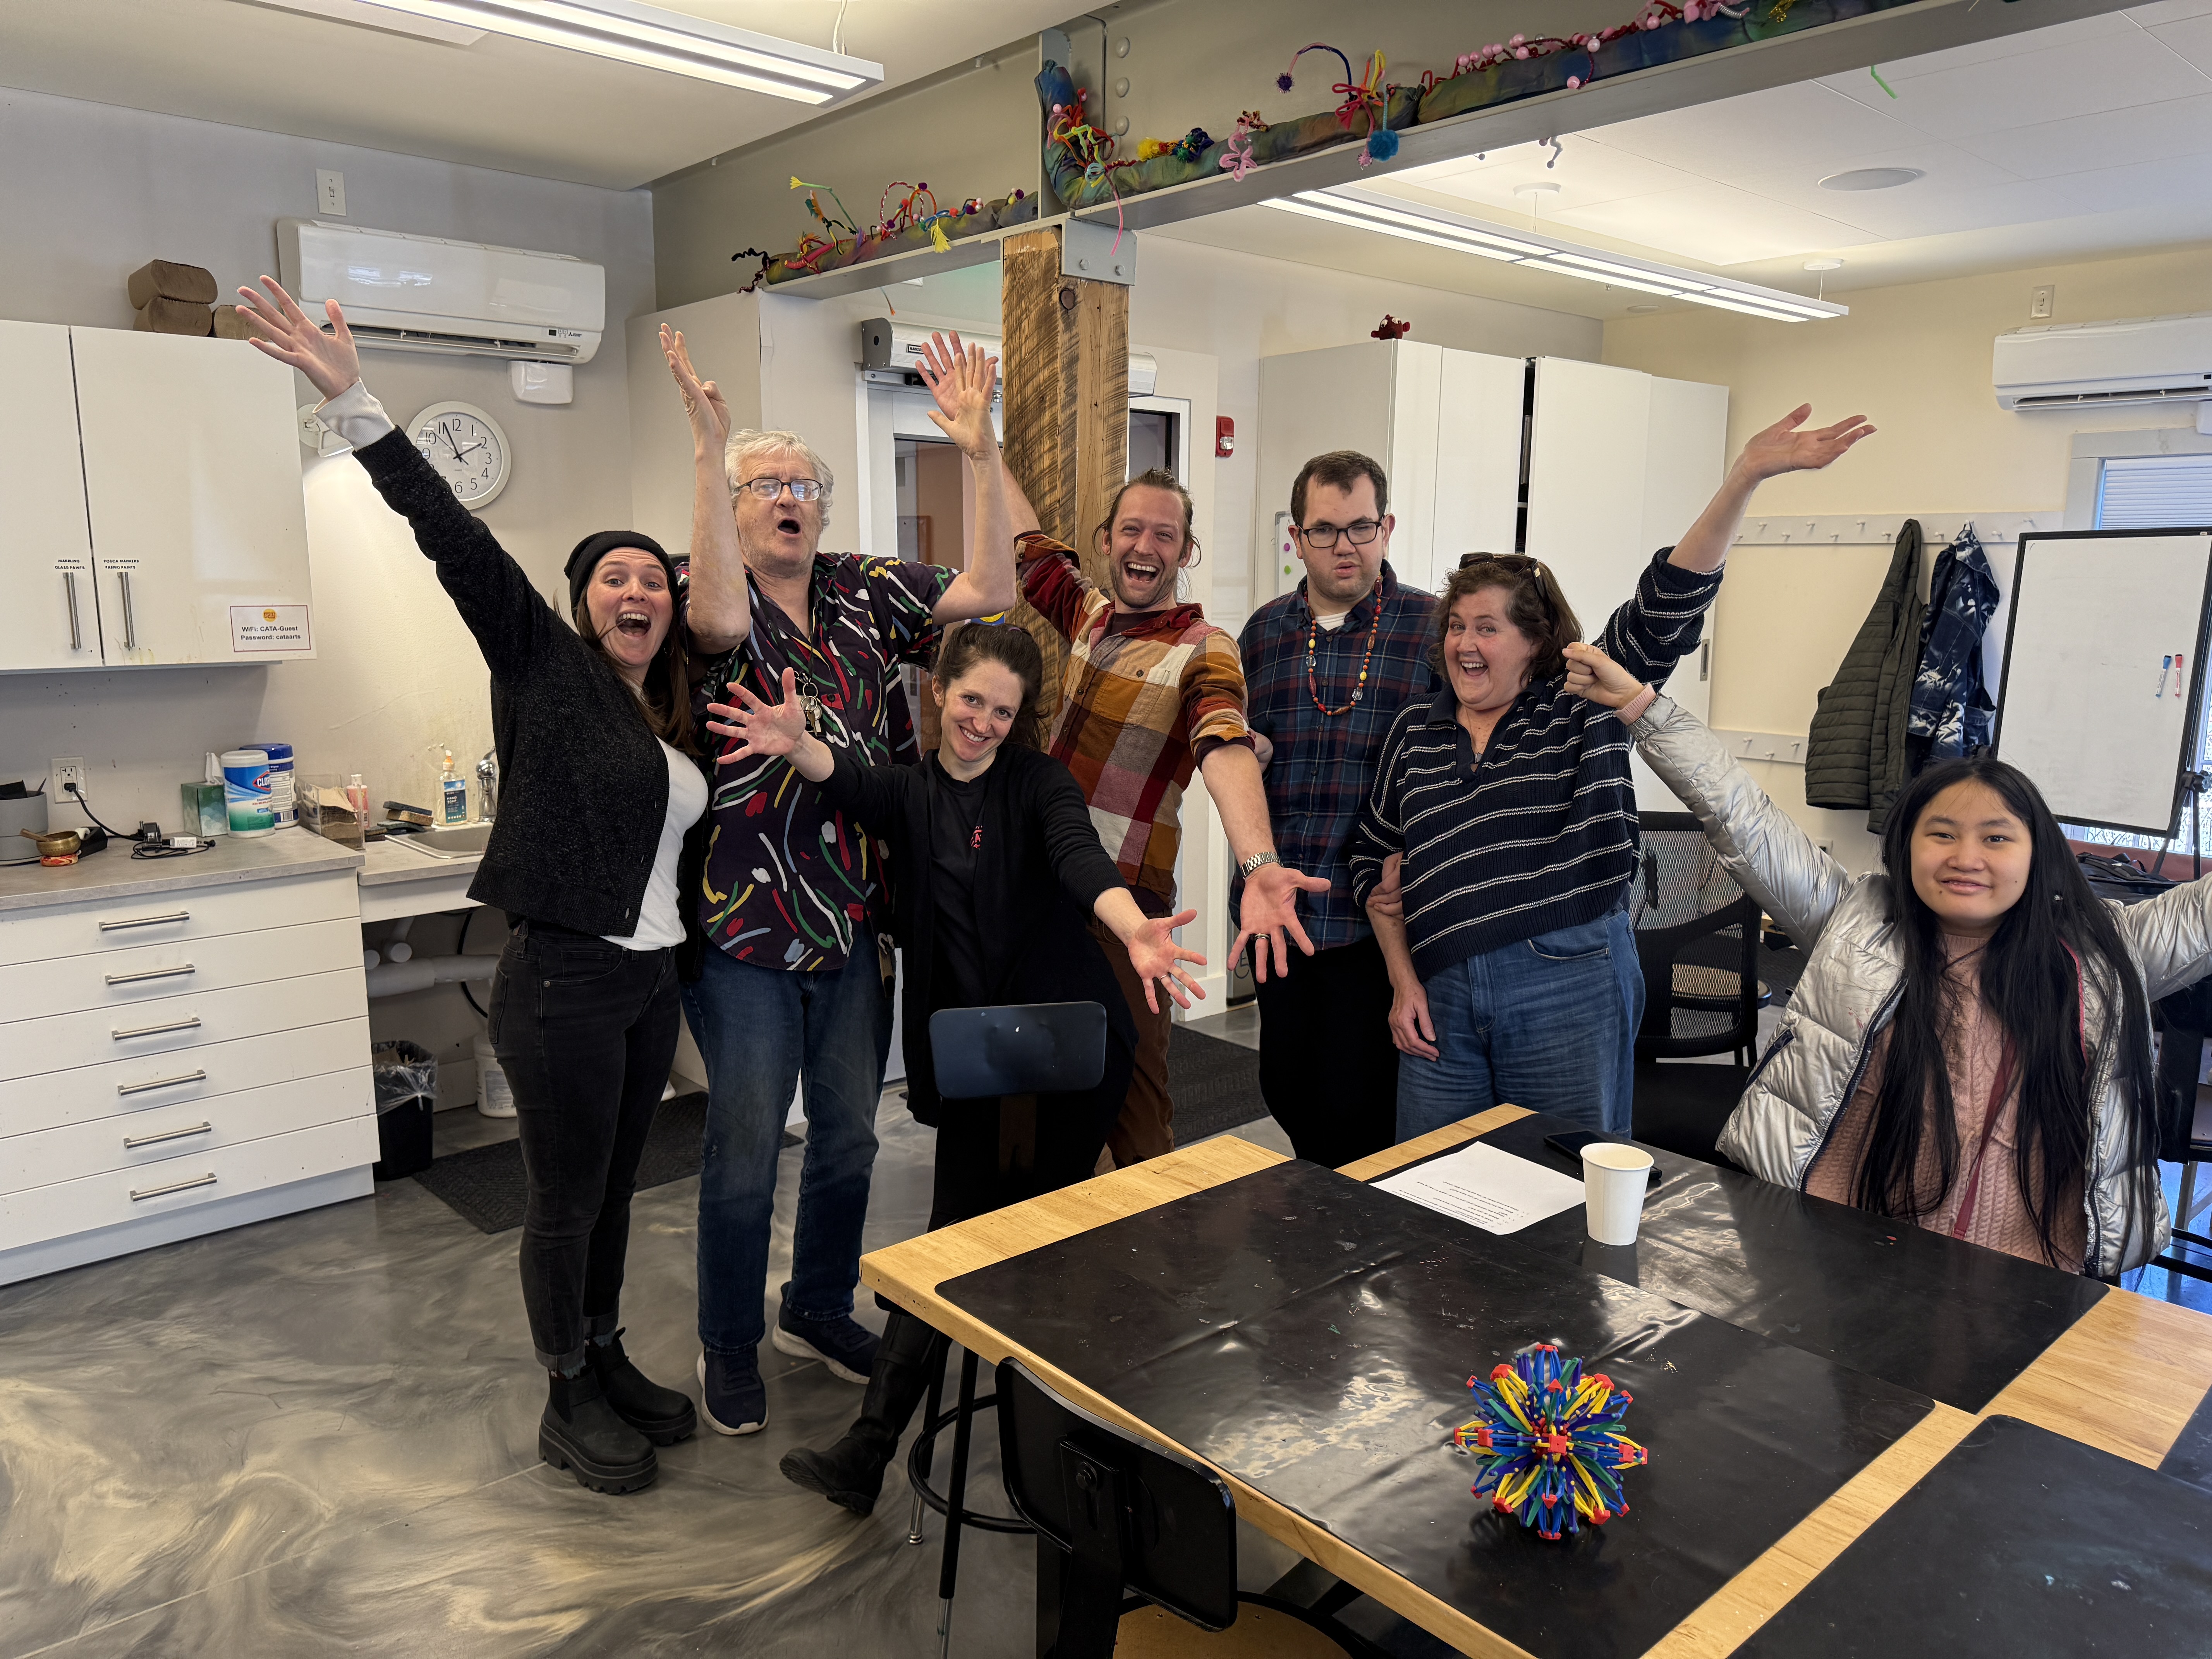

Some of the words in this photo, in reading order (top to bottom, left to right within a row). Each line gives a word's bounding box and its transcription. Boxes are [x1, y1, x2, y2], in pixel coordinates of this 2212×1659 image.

[438, 421, 445, 434] 11
[452, 419, 461, 431] 12
[471, 424, 474, 436] 1
[426, 432, 436, 445] 10
[481, 437, 487, 449] 2
[422, 448, 430, 460] 9
[485, 452, 492, 464] 3
[481, 467, 489, 479] 4
[455, 481, 463, 493] 6
[471, 478, 477, 490] 5
